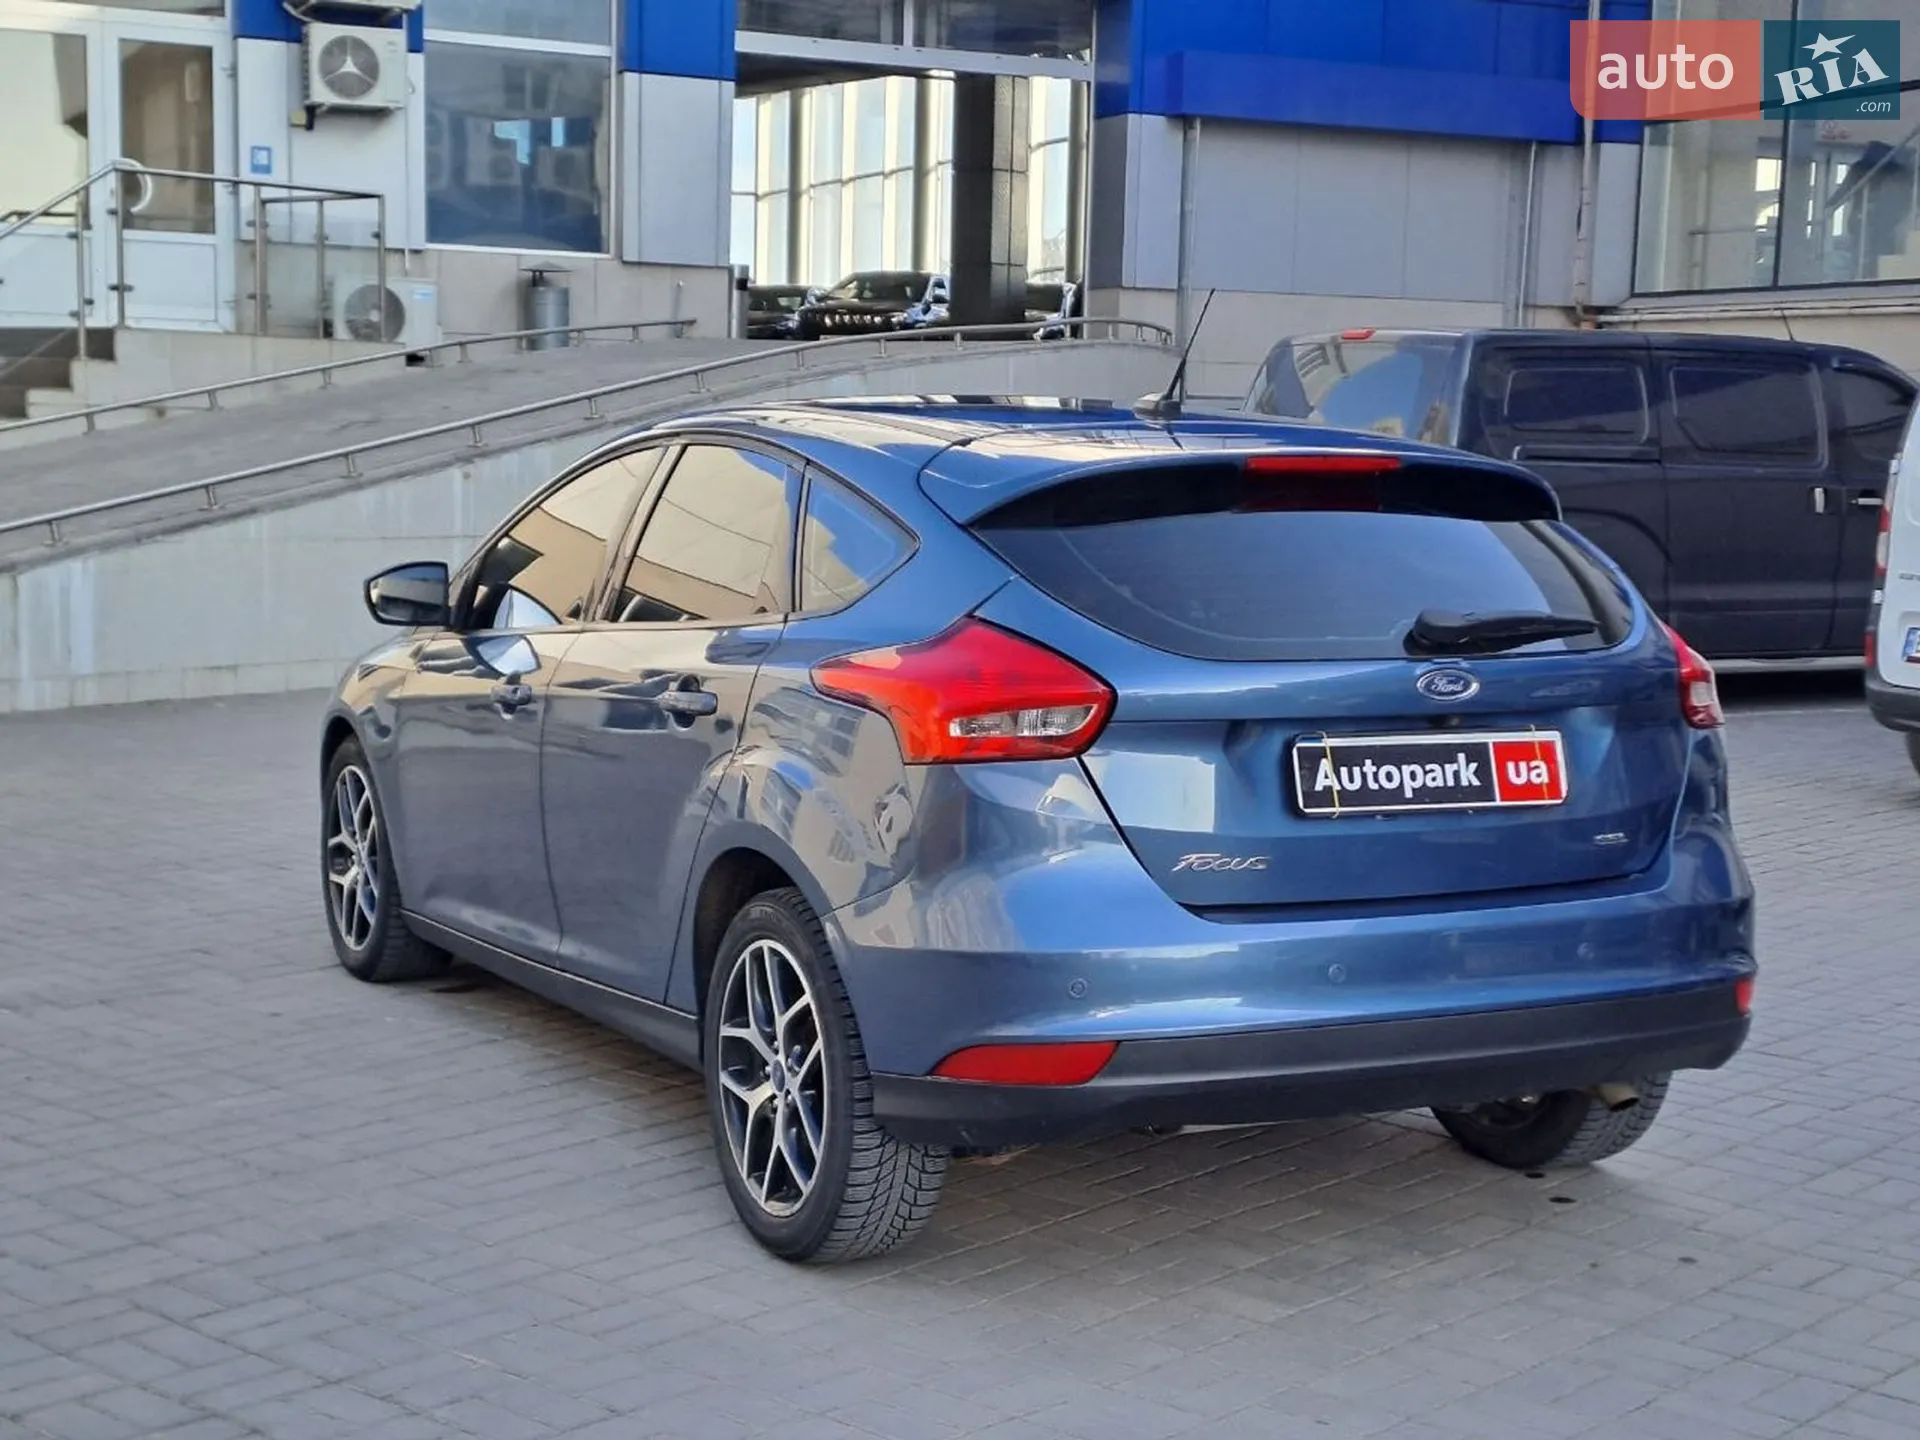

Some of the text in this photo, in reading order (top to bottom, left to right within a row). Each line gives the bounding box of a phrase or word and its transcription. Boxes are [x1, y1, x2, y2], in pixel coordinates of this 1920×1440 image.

[1430, 675, 1465, 692] Ford
[1314, 753, 1550, 798] Autopark ua
